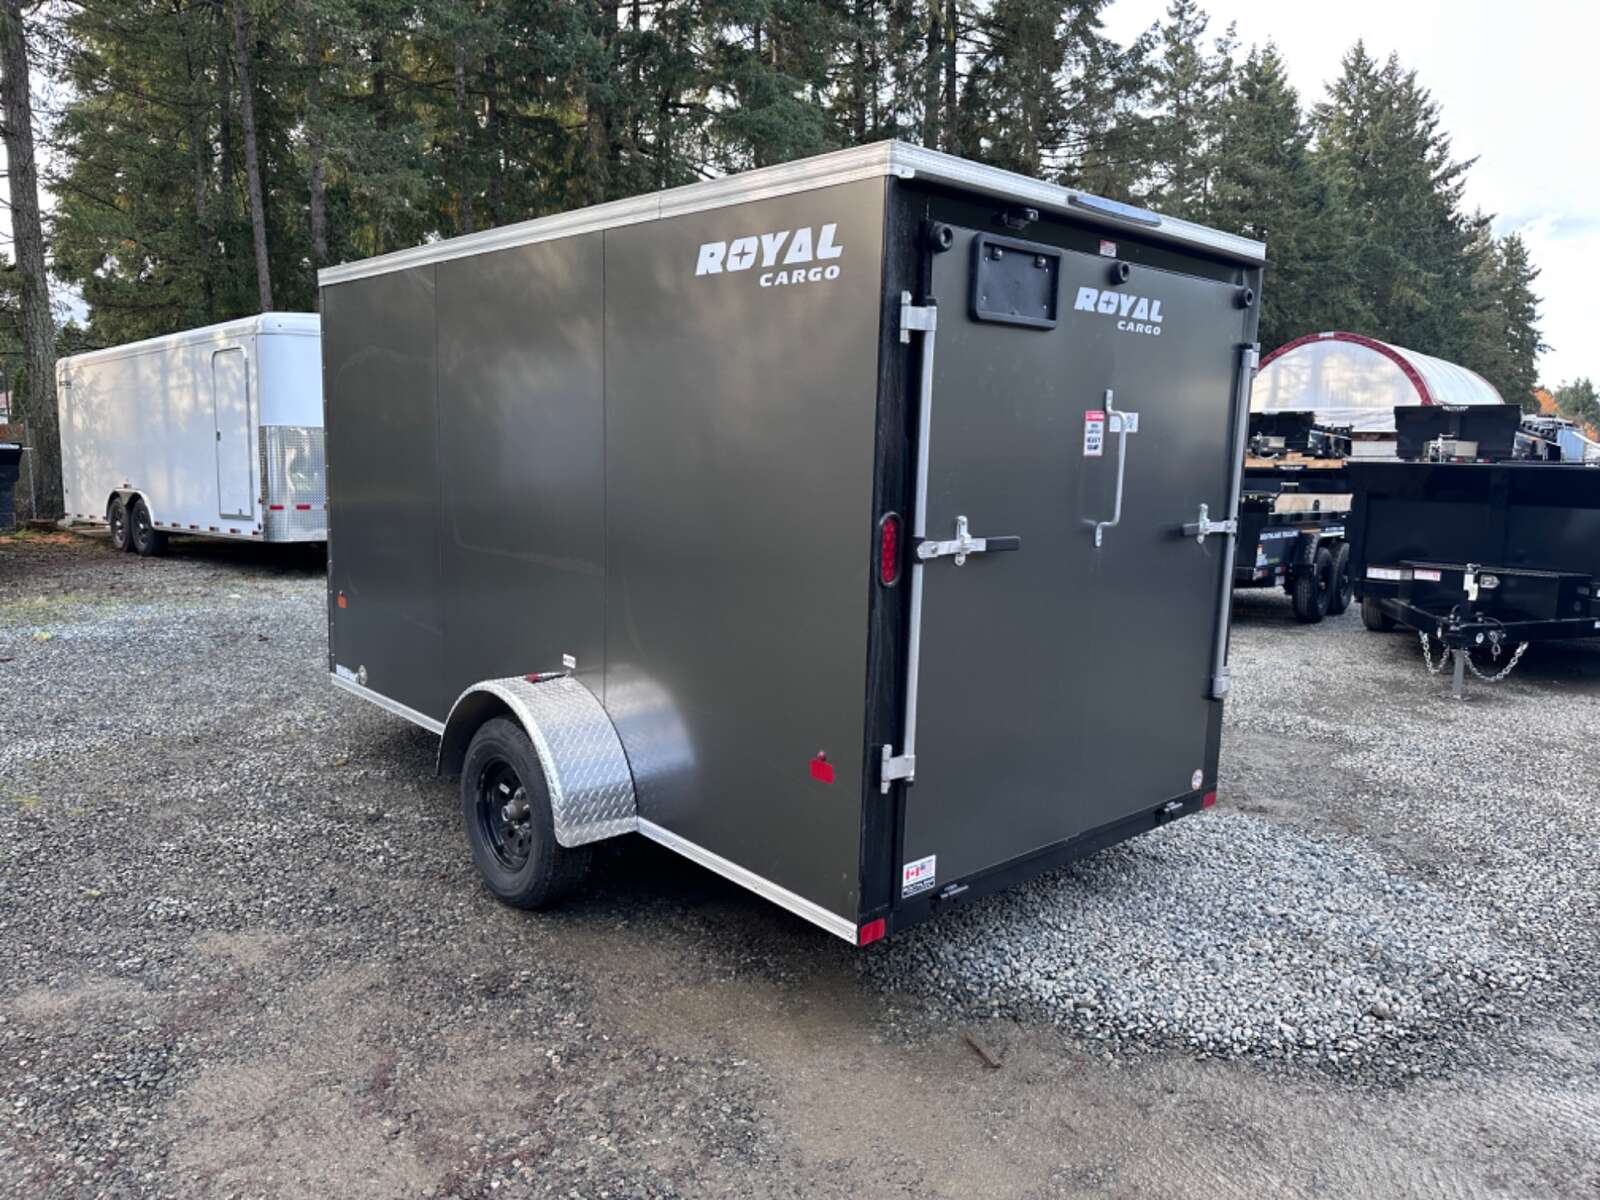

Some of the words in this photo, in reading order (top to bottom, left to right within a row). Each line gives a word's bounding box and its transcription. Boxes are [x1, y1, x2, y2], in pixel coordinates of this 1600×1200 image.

[695, 223, 843, 276] ROYAL
[760, 265, 841, 288] CARGO
[1074, 286, 1163, 322] ROYAL
[1117, 321, 1161, 336] CARGO
